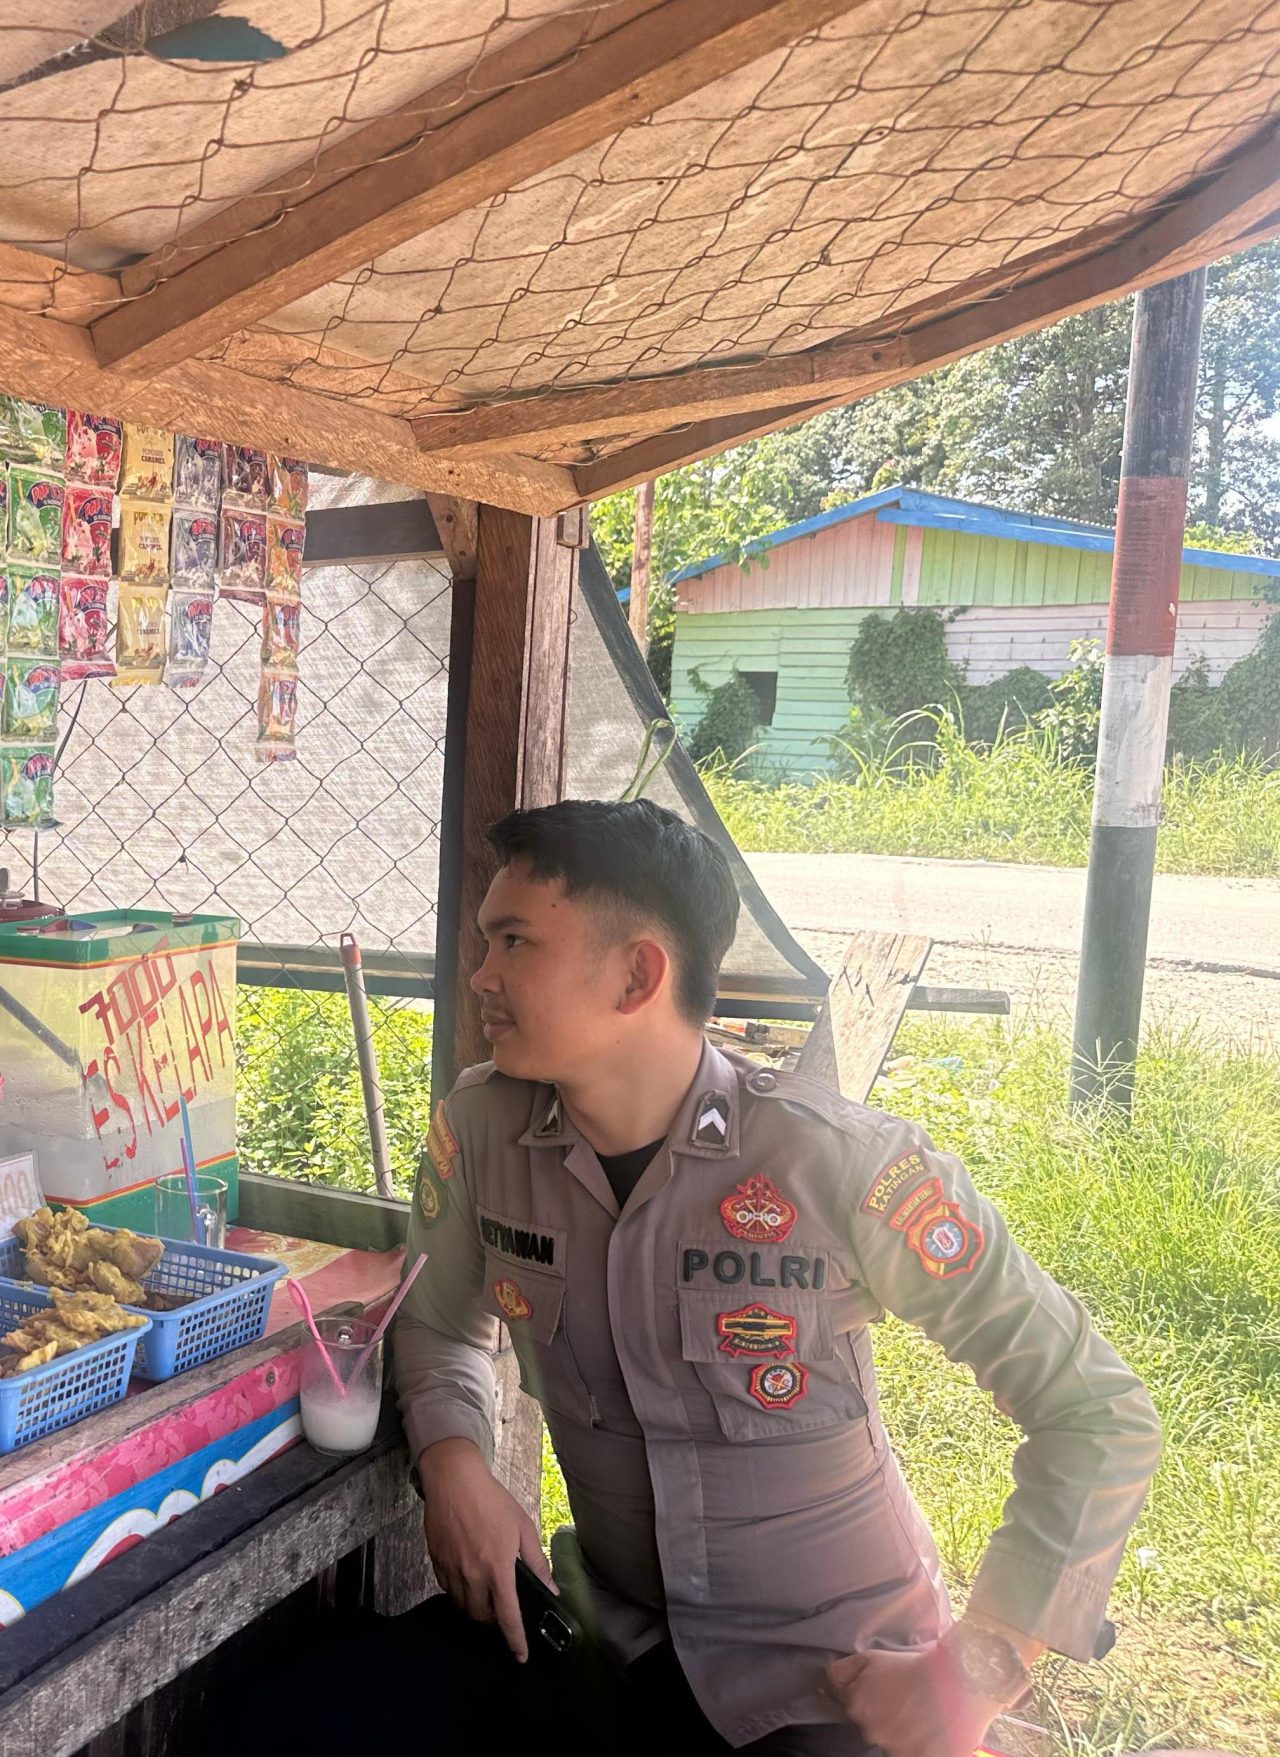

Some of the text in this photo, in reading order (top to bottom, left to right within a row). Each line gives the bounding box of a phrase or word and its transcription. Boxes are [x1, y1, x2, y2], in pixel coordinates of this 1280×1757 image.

[83, 959, 236, 1172] ES KELAPA
[868, 1154, 921, 1209] POLRES
[877, 1164, 926, 1212] KATINGAN
[682, 1248, 825, 1290] POLRI
